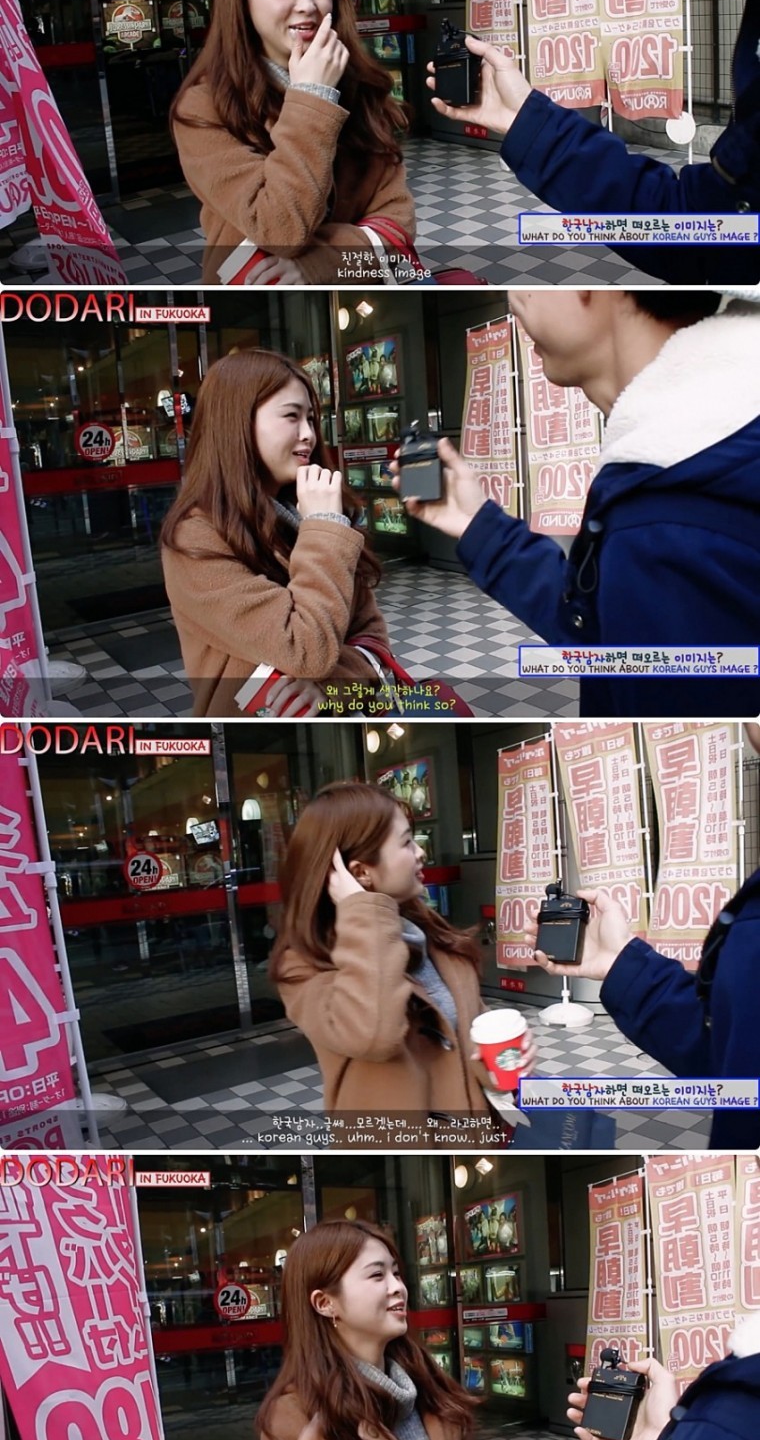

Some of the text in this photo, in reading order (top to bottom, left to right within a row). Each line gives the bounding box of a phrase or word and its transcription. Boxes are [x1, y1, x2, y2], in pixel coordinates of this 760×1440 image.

[82, 430, 111, 448] 24h
[130, 858, 158, 877] 24h
[220, 1289, 247, 1307] 24h
